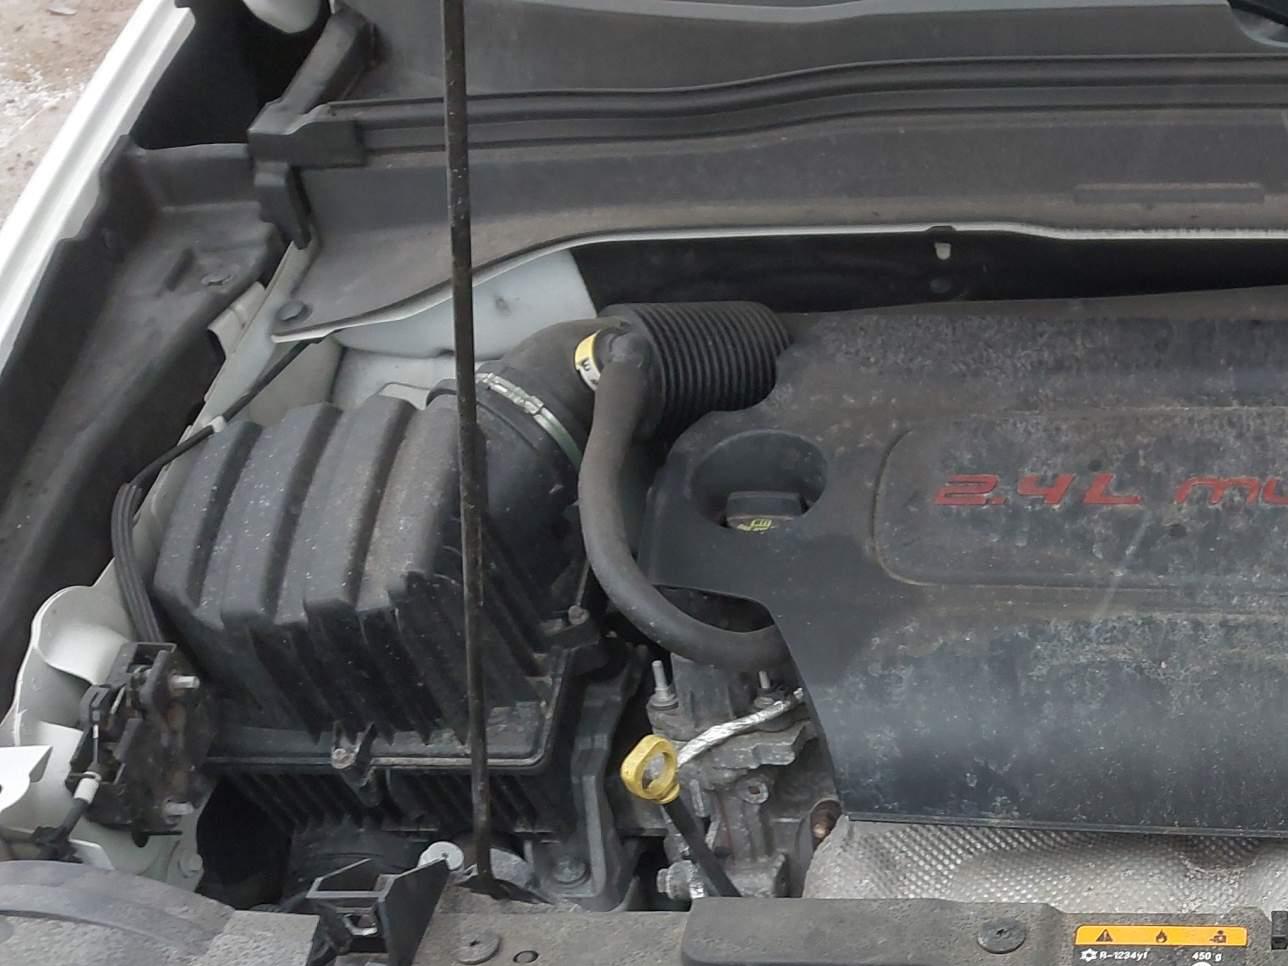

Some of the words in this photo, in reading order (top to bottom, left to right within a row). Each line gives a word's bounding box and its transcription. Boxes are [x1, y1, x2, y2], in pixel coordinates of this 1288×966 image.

[934, 473, 1143, 506] 2.4L
[1099, 950, 1148, 961] R-1234yf
[1191, 951, 1212, 961] 450
[1214, 952, 1222, 962] g
